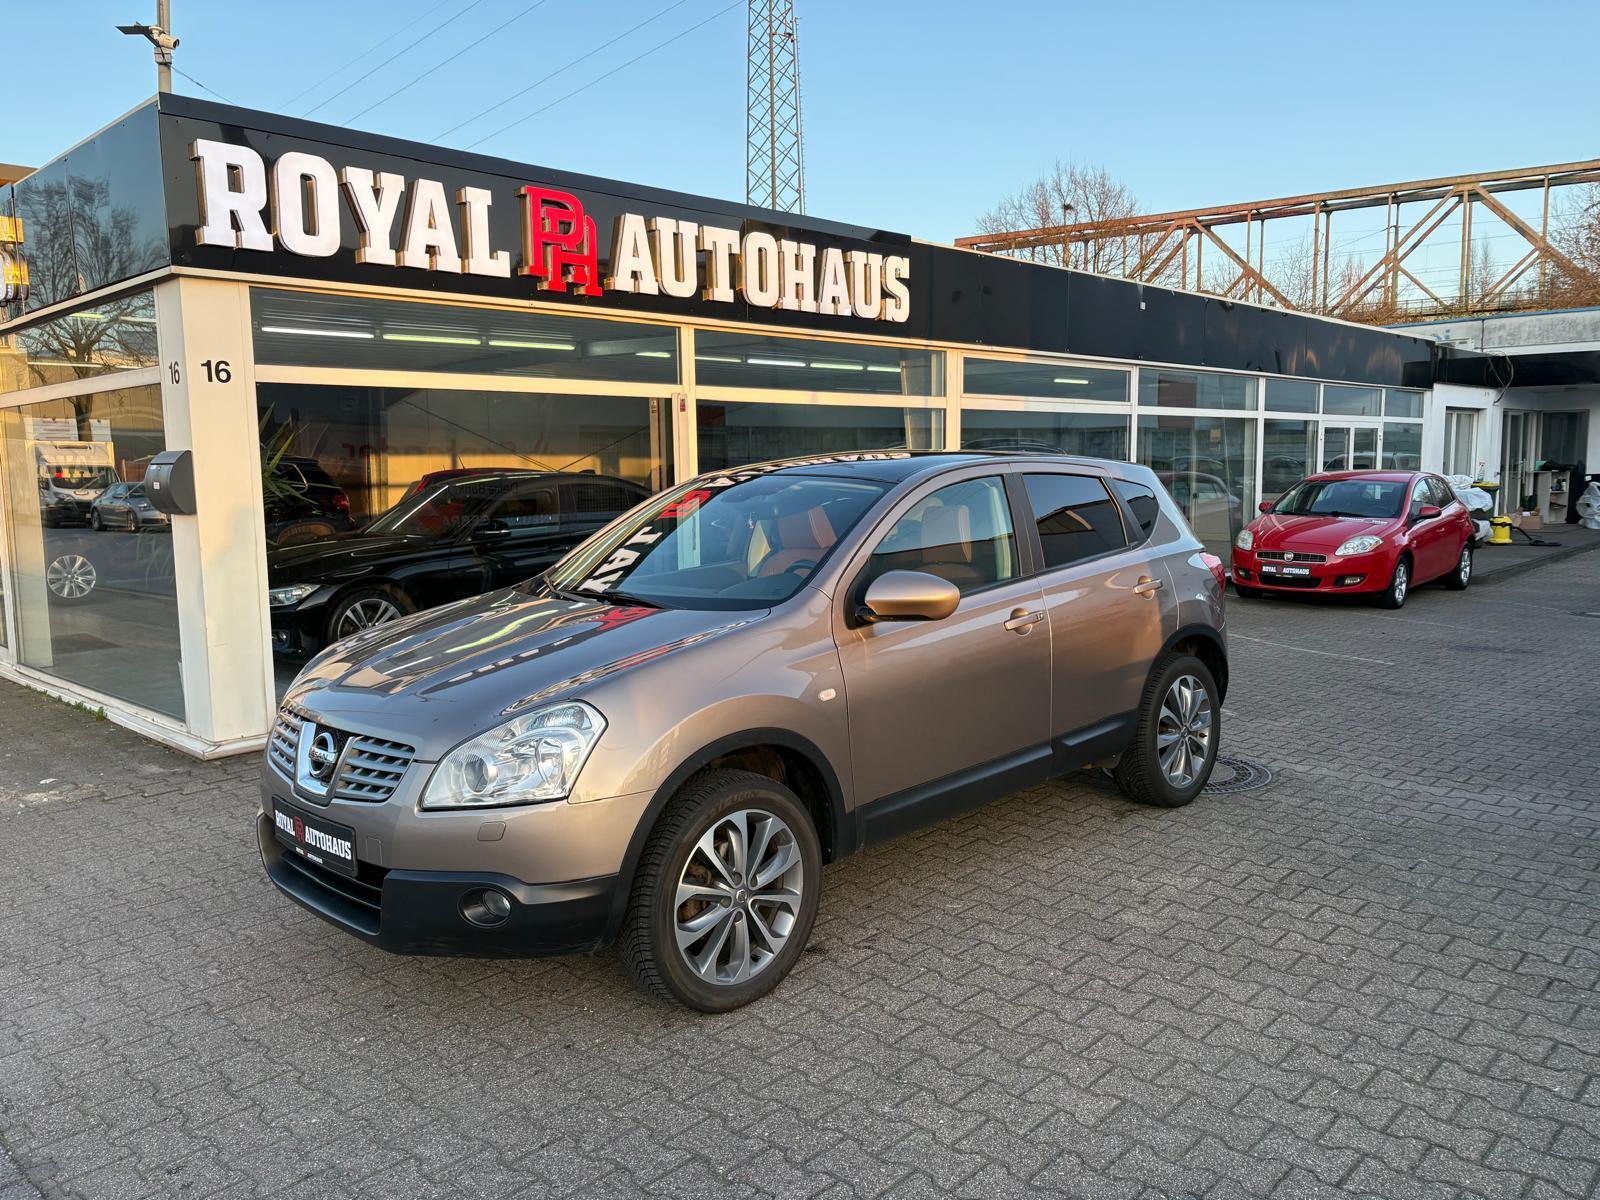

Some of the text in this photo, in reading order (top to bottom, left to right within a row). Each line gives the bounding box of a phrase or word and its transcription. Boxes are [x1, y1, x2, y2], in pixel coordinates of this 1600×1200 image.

[189, 138, 511, 278] ROYAL
[604, 213, 911, 322] AUTOHAUS
[169, 361, 180, 384] 16
[201, 360, 231, 383] 16
[275, 810, 295, 836] ROYAL
[305, 826, 352, 860] AUTOHAUS
